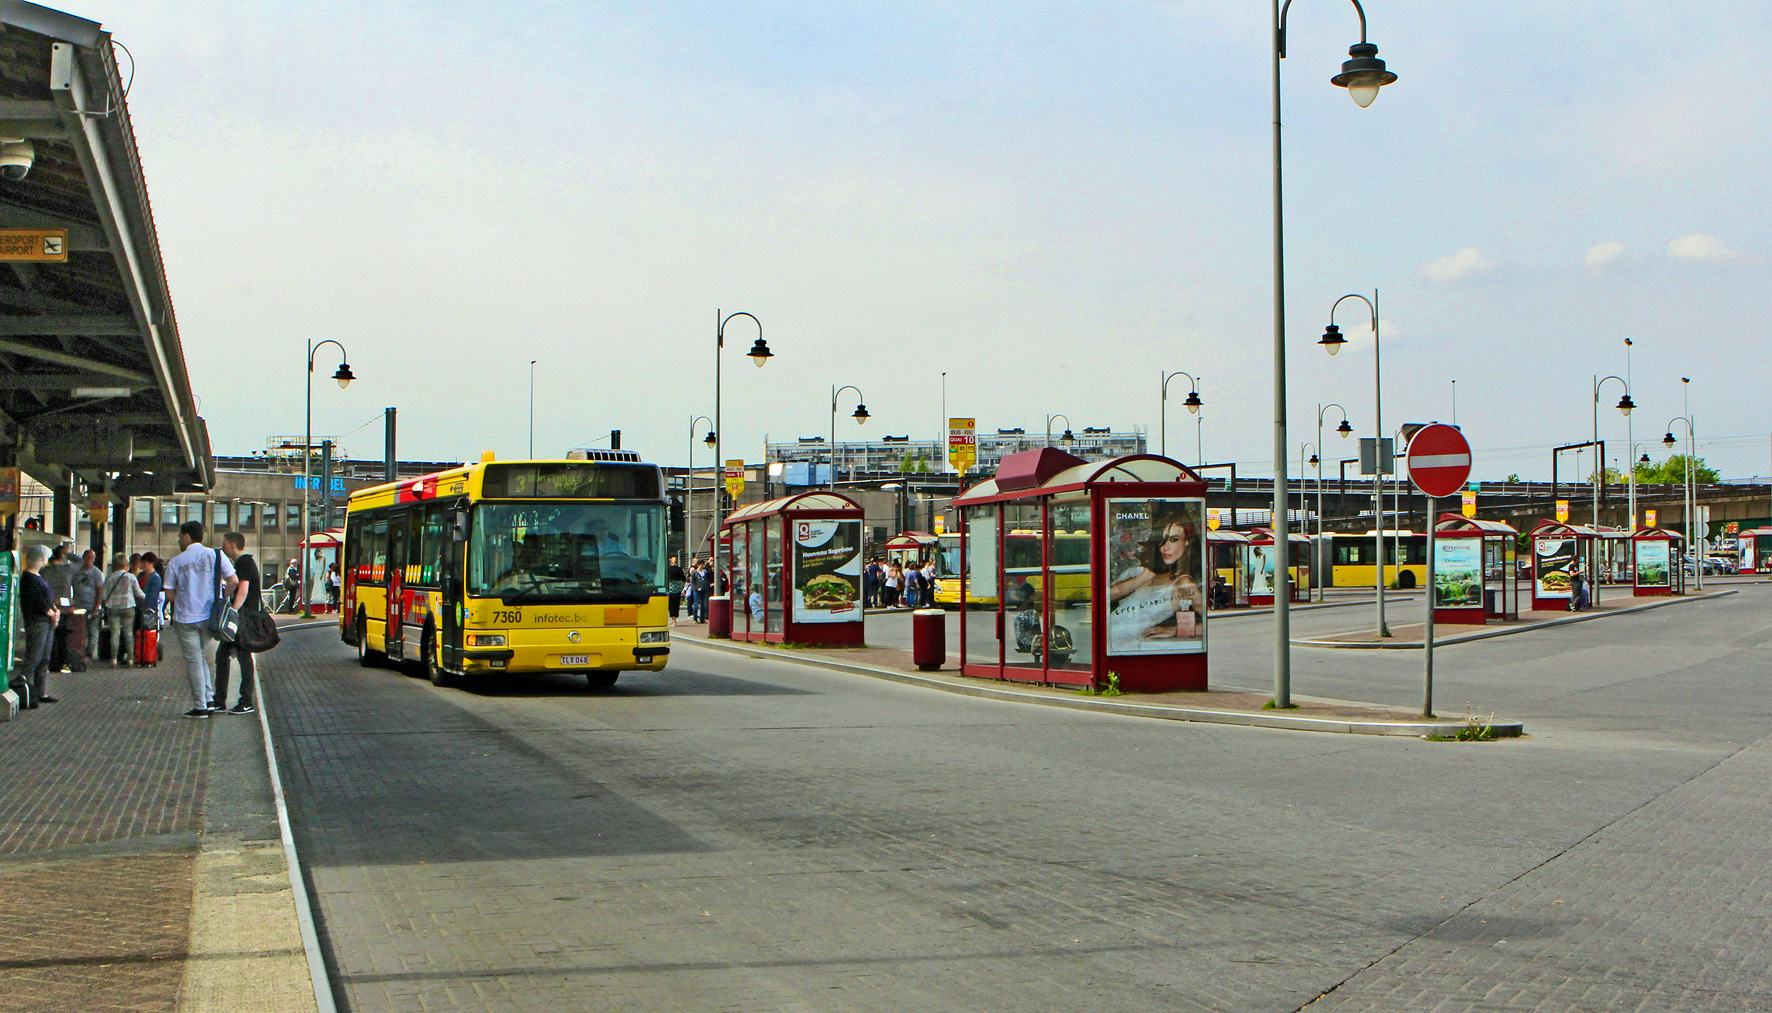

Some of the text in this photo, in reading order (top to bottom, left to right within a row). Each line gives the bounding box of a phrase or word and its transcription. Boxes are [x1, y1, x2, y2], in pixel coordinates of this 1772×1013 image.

[0, 245, 33, 254] IRPORT
[964, 436, 975, 444] 10
[1115, 512, 1150, 520] CHANEL
[493, 611, 522, 623] 7360
